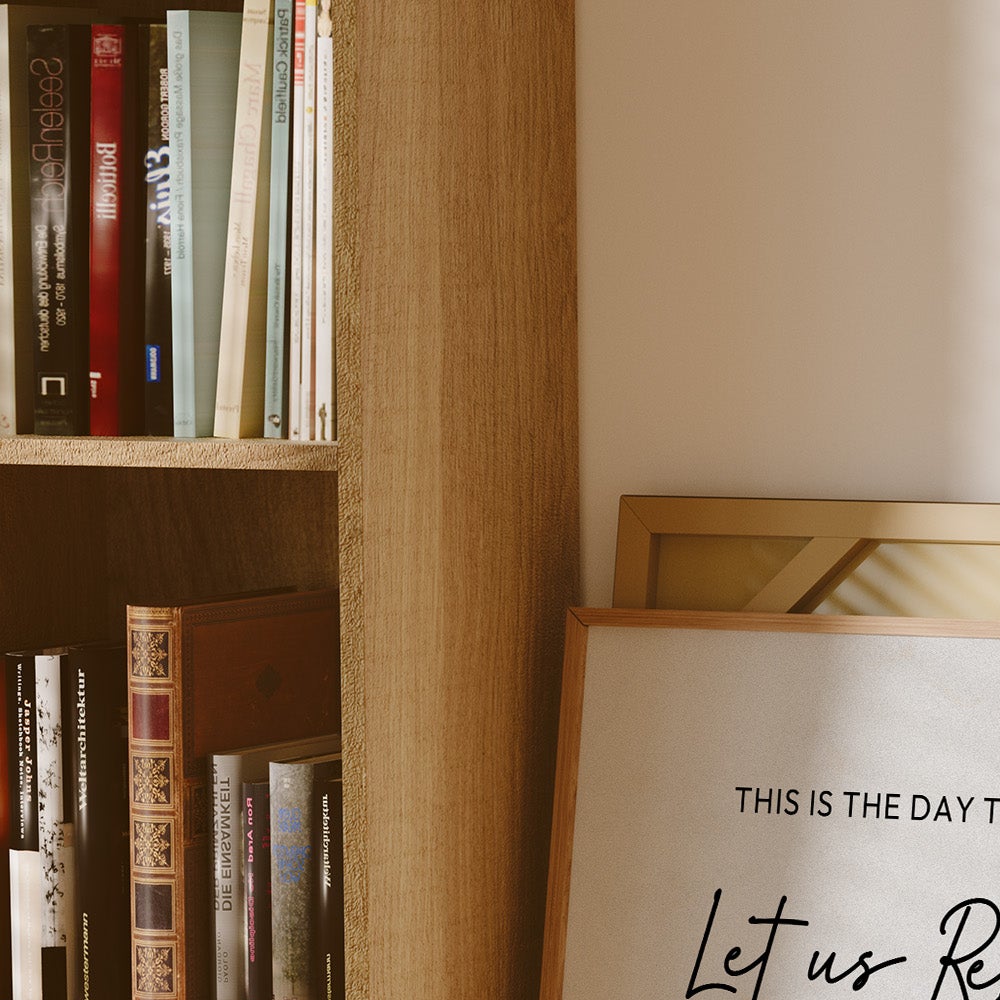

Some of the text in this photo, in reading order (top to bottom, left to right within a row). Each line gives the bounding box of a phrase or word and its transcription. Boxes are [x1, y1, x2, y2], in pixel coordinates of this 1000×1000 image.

[23, 699, 32, 751] Jasper
[76, 668, 86, 811] Weltarchitektur
[735, 786, 800, 816] THIS
[810, 790, 833, 817] IS
[843, 791, 901, 820] THE
[911, 794, 974, 823] DAY
[807, 951, 907, 991] us
